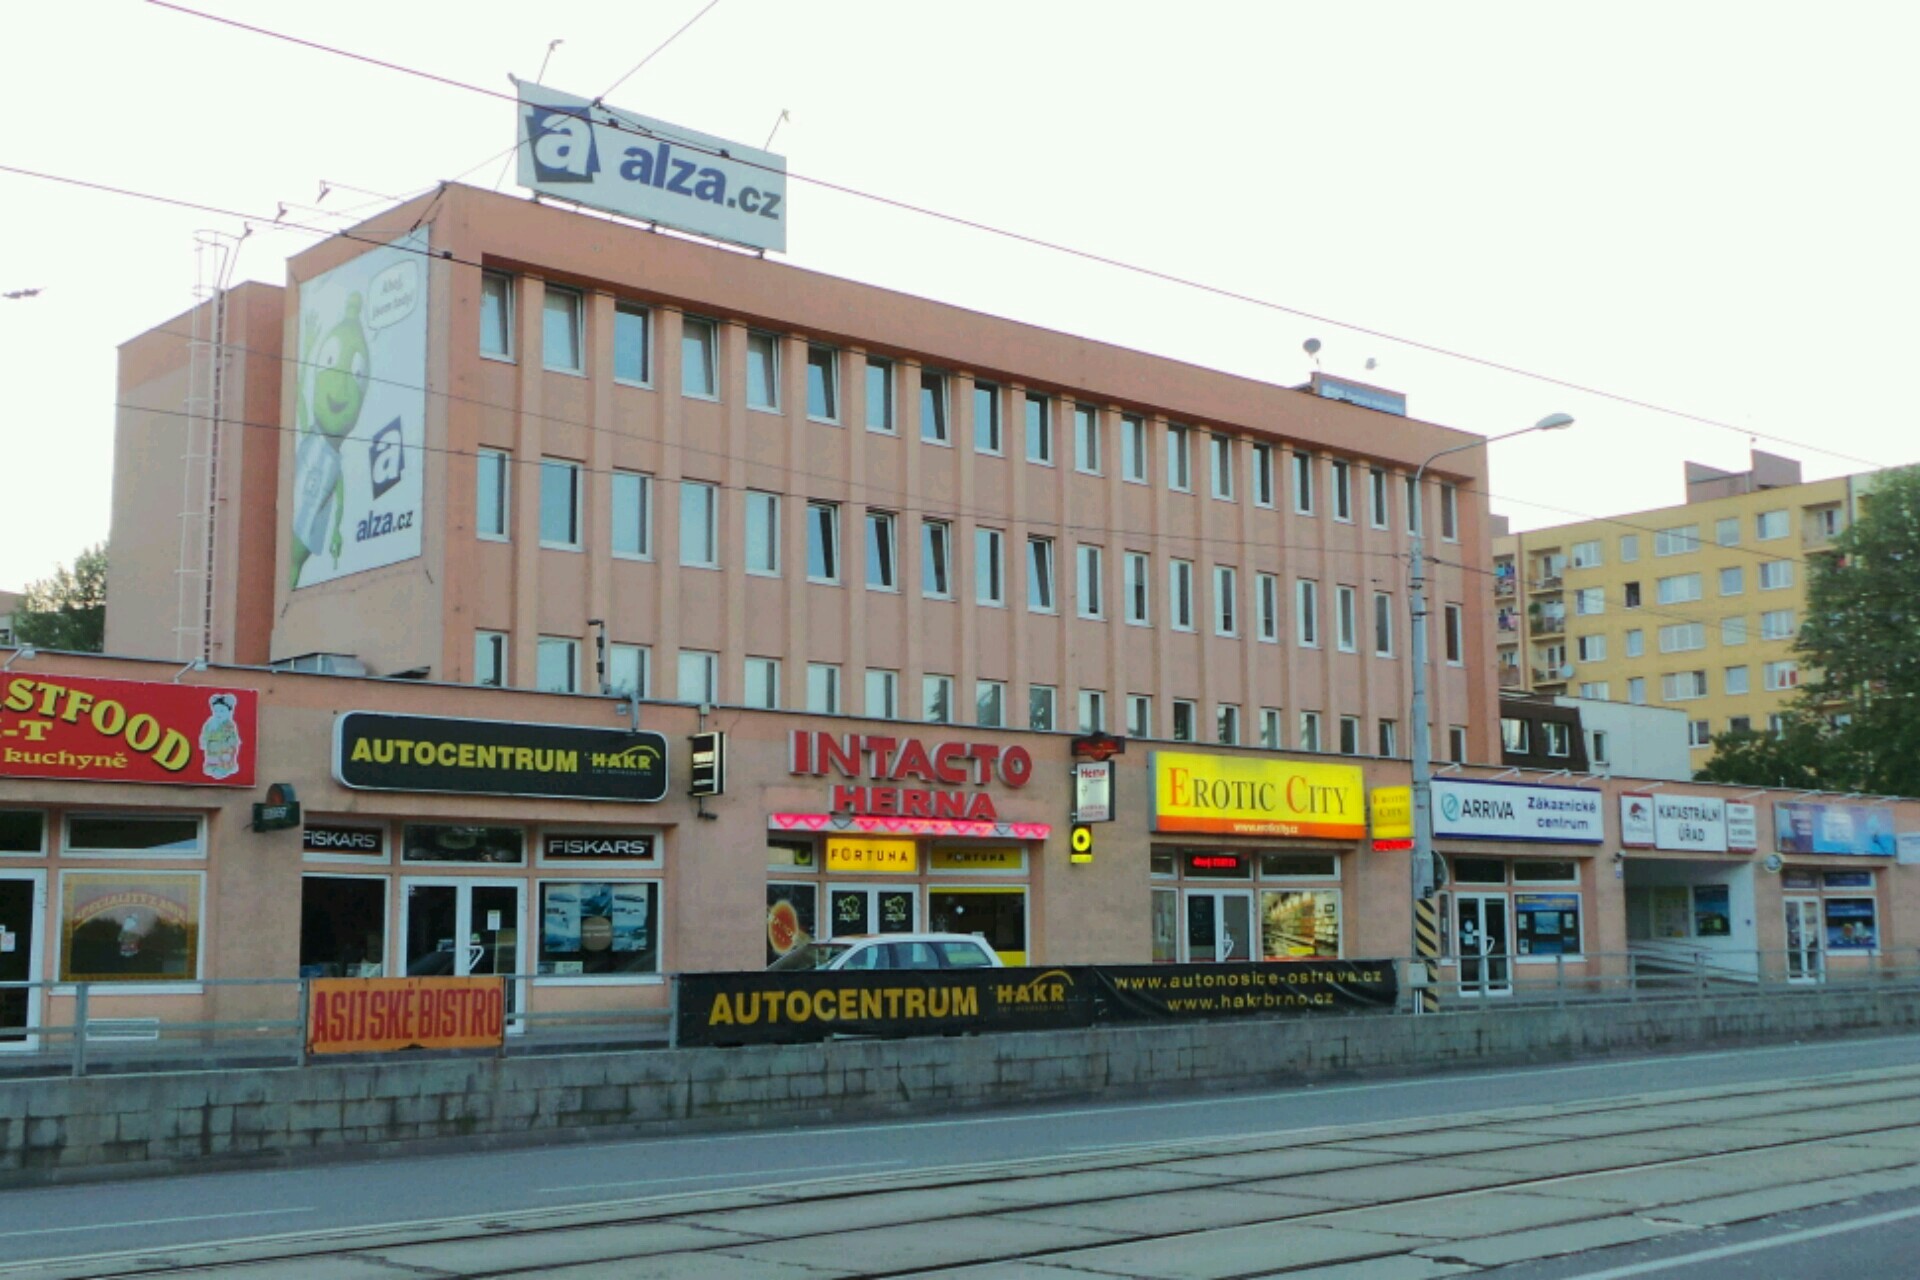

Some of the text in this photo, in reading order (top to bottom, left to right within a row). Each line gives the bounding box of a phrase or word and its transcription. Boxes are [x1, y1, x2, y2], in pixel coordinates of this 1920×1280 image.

[619, 142, 783, 220] alza.cz
[356, 509, 414, 543] alza.cz
[0, 678, 191, 772] STFOOD
[4, 747, 129, 770] kuchyně
[351, 737, 652, 774] AUTOCENTRUM HAKR
[788, 729, 1033, 789] INTACTO
[829, 784, 998, 820] HERNA
[1168, 767, 1349, 816] EROTIC CITY
[1461, 795, 1597, 820] ARRIVA Zákaznické
[1537, 816, 1589, 831] centrum
[549, 839, 646, 854] FISKARS
[831, 848, 909, 863] FORTUNA
[313, 980, 502, 1044] ASIJSKÉ BISTRO
[708, 983, 1065, 1027] AUTOCENTRUM HAKR
[1167, 992, 1334, 1012] www.hakrbrno.cz
